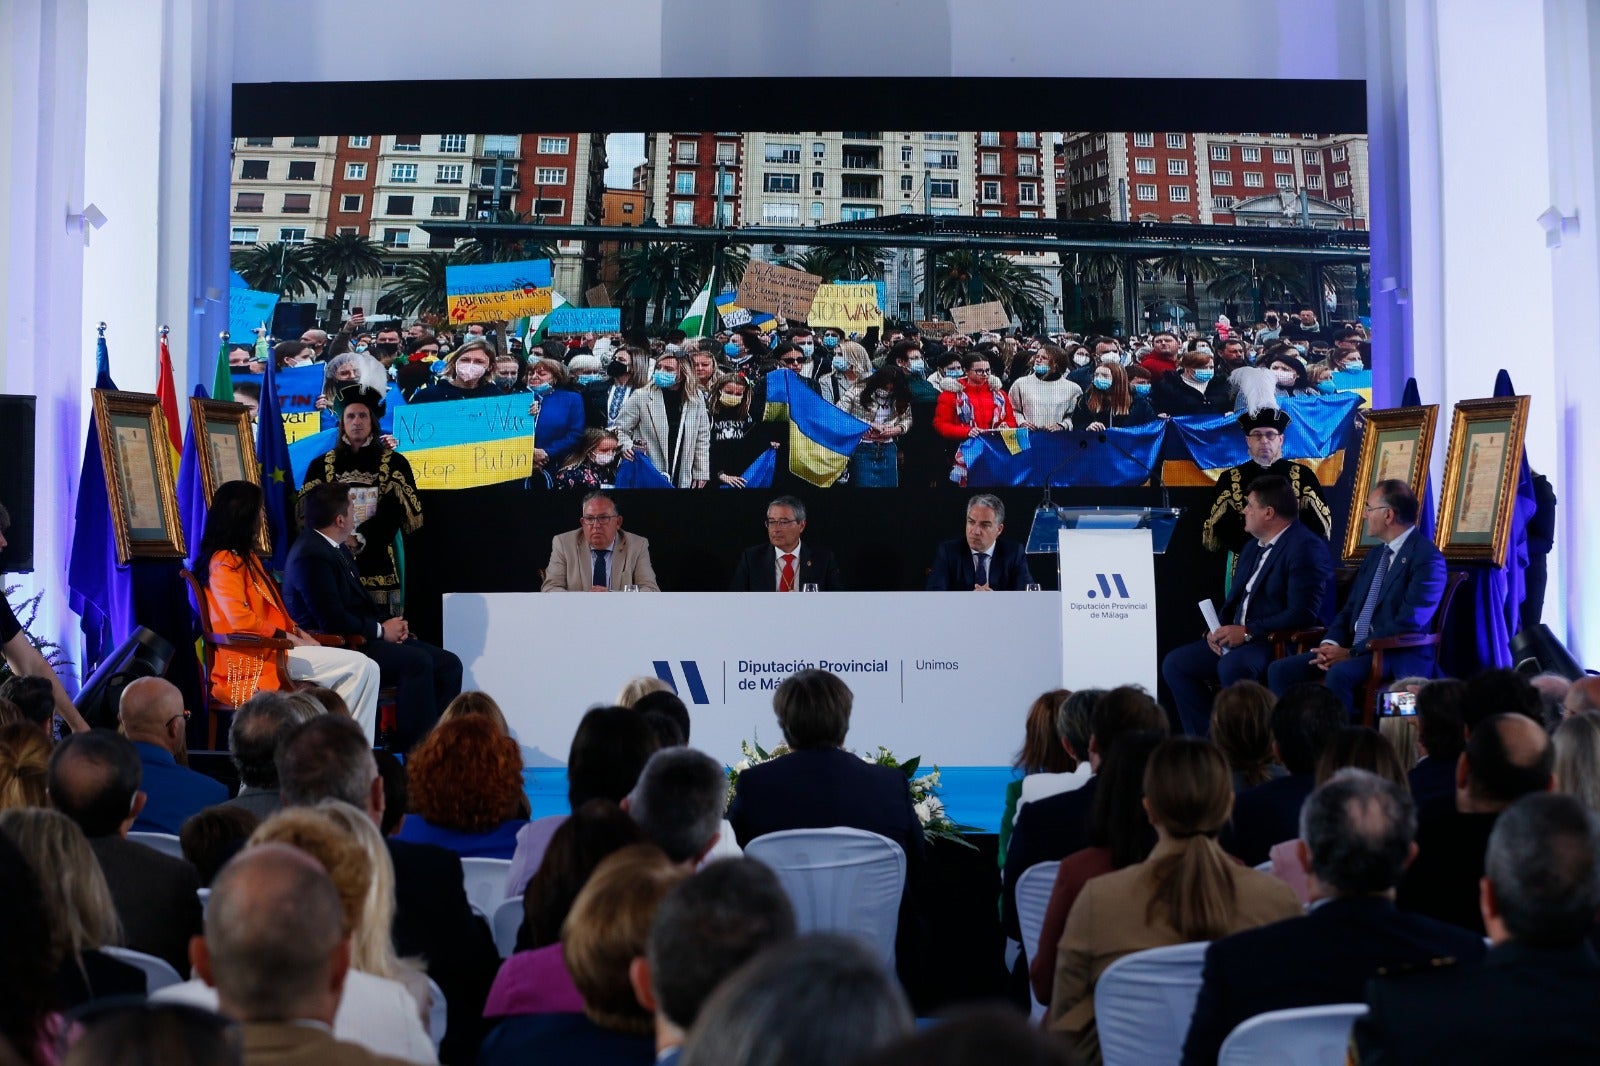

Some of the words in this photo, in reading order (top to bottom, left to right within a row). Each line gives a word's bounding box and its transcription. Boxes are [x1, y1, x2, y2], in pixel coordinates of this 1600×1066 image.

[836, 287, 875, 298] PUTIN
[471, 309, 504, 322] STOP
[843, 303, 876, 322] WAR
[279, 395, 312, 407] TIN
[399, 411, 435, 445] No
[483, 400, 525, 433] War
[474, 447, 527, 475] Putin
[1070, 603, 1110, 611] Diputación
[1090, 611, 1100, 619] de
[1102, 611, 1129, 620] Málaga
[738, 659, 815, 675] Diputación
[819, 659, 888, 673] Provincial
[916, 659, 959, 671] Unimos
[738, 677, 757, 691] de
